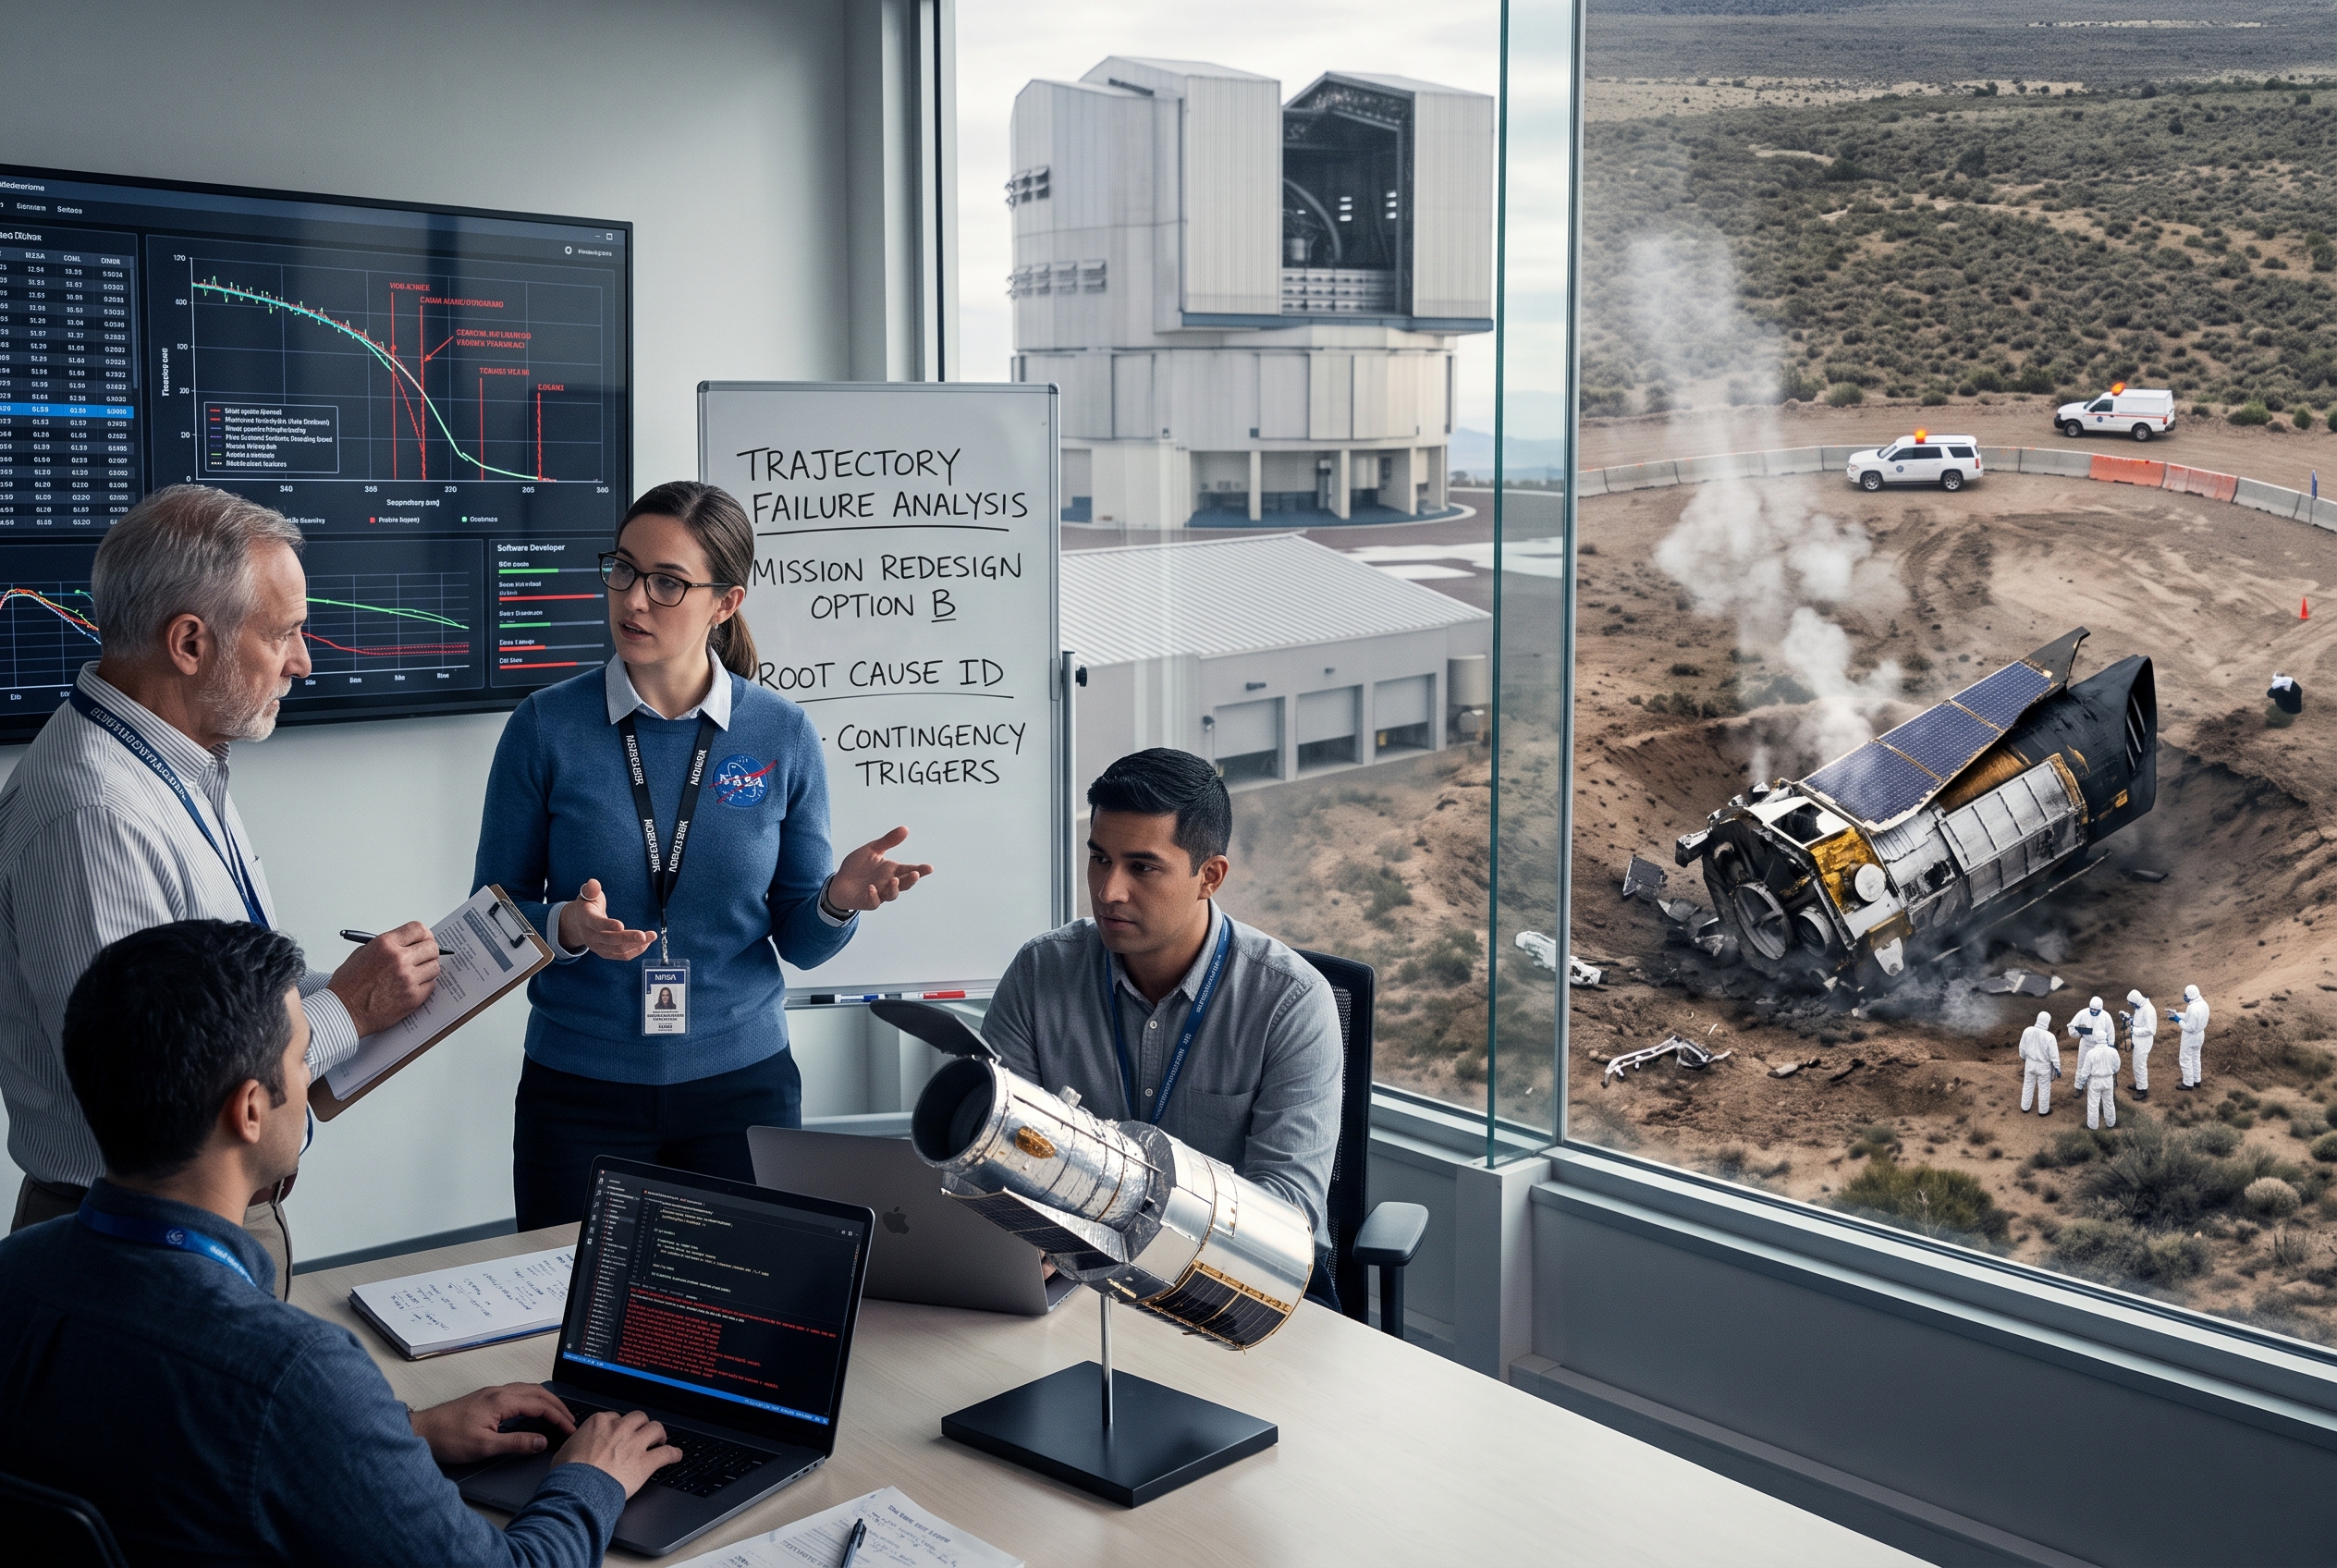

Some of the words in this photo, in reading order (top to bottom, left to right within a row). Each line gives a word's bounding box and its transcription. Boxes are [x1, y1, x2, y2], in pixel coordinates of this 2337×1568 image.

[737, 447, 960, 485] TRAJECTORY
[753, 492, 875, 523] FAILURE
[893, 492, 1027, 520] ANALYSIS
[497, 544, 529, 552] Software
[531, 544, 566, 553] Developer
[752, 557, 863, 586] MISSION
[881, 553, 1021, 581] REDESIGN
[812, 594, 913, 619] OPTION
[932, 589, 957, 619] B
[758, 662, 836, 691] ROOT
[850, 660, 943, 686] CAUSE
[960, 659, 1003, 687] ID
[838, 723, 1025, 754] CONTINGENCY
[855, 759, 999, 786] TRIGGERS
